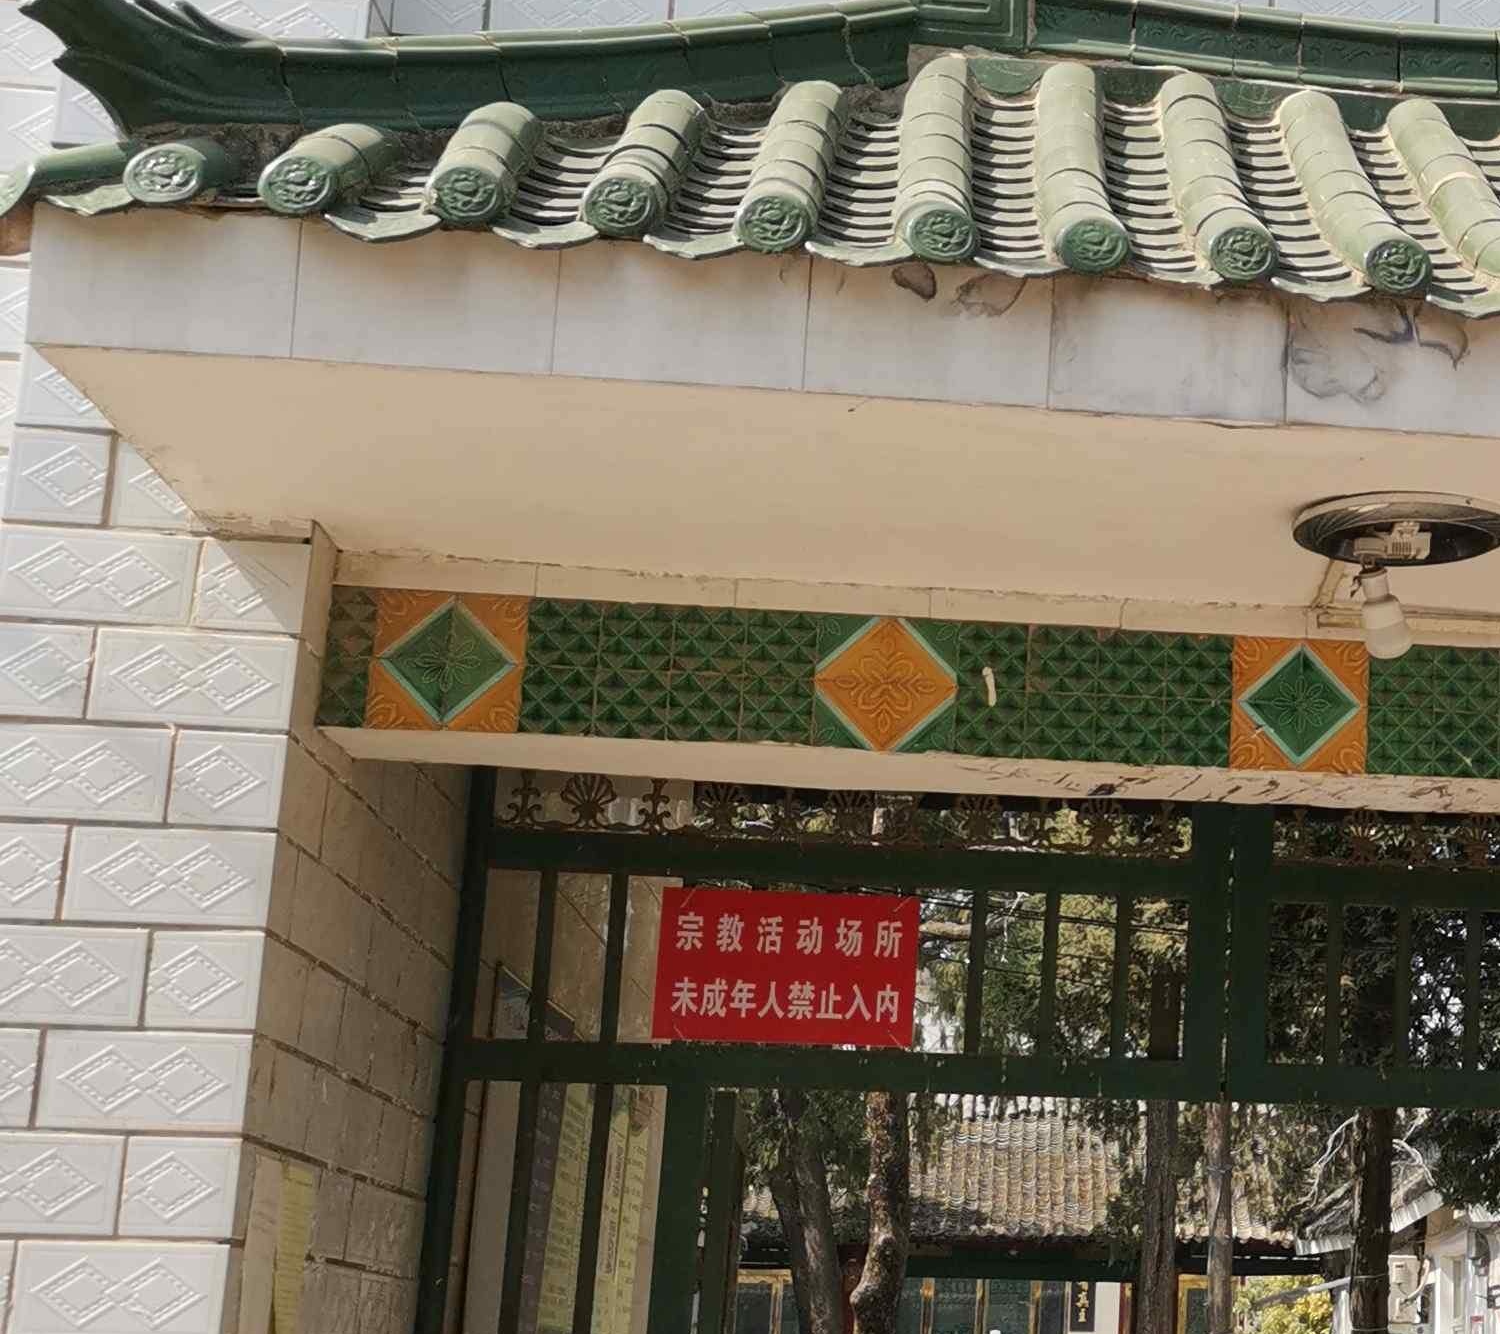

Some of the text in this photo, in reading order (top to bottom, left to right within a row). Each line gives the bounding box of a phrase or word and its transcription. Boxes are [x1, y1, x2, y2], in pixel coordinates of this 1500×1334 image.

[675, 911, 903, 959] 宗教活动场所
[670, 976, 900, 1024] 未成年人禁止入内
